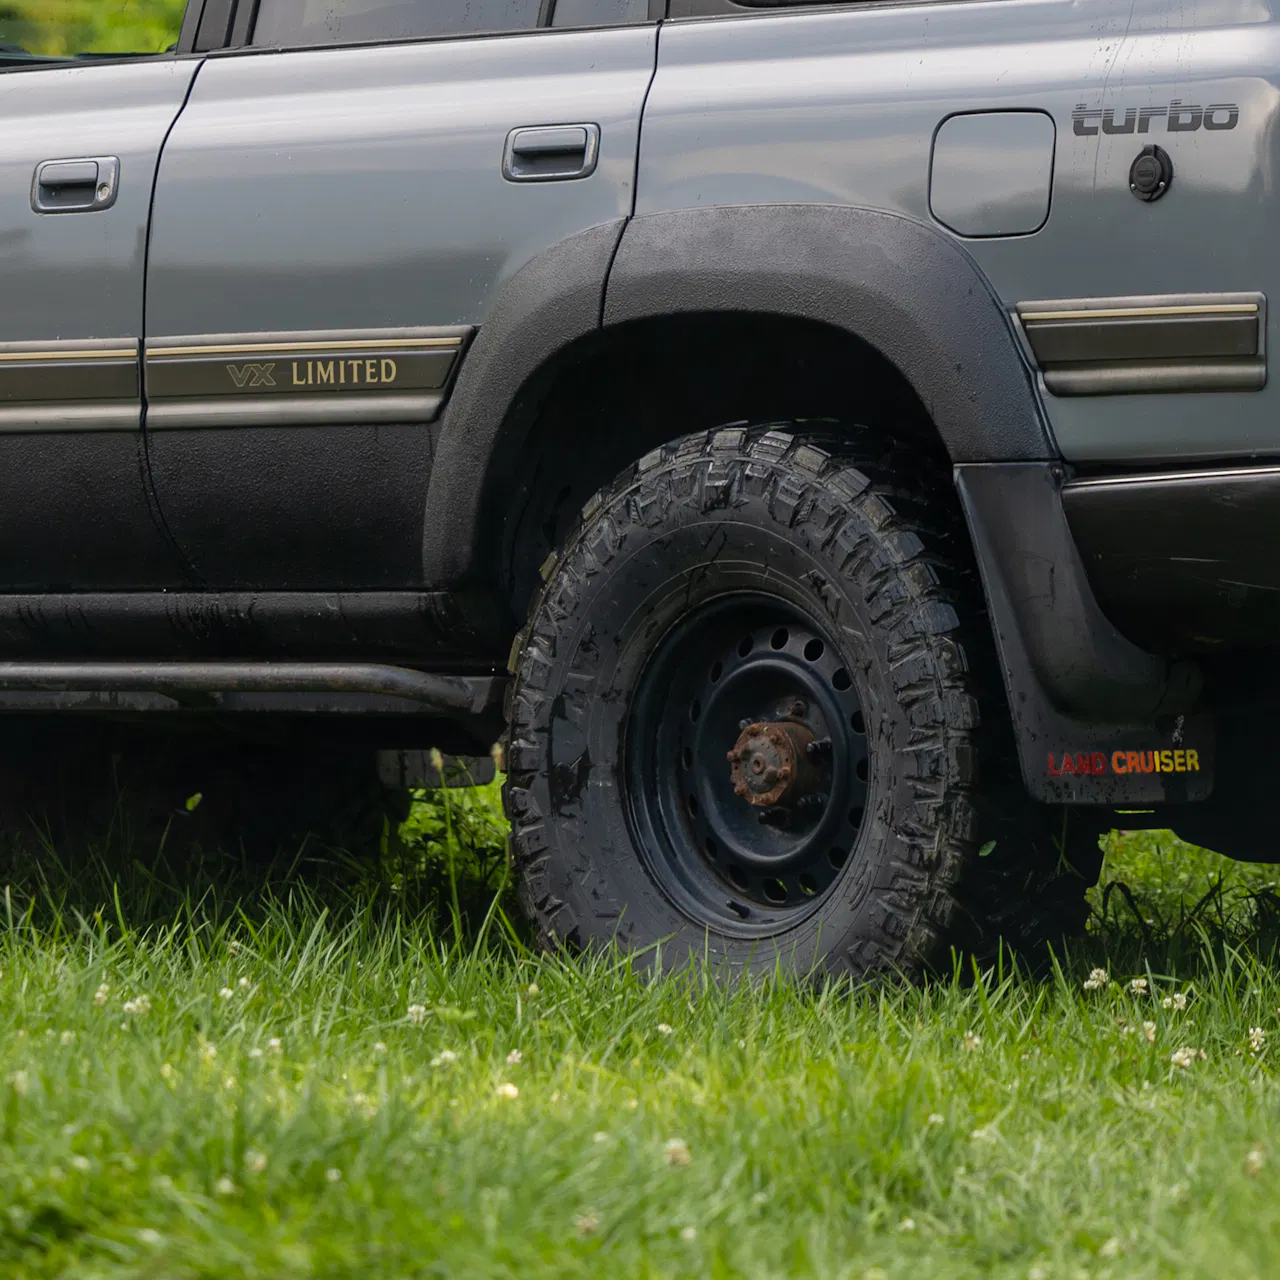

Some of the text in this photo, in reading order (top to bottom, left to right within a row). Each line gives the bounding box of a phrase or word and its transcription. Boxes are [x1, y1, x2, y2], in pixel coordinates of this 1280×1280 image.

[1071, 98, 1239, 136] turbo
[226, 358, 397, 387] VX LIMITED
[1047, 749, 1200, 776] LAND CRUISER
